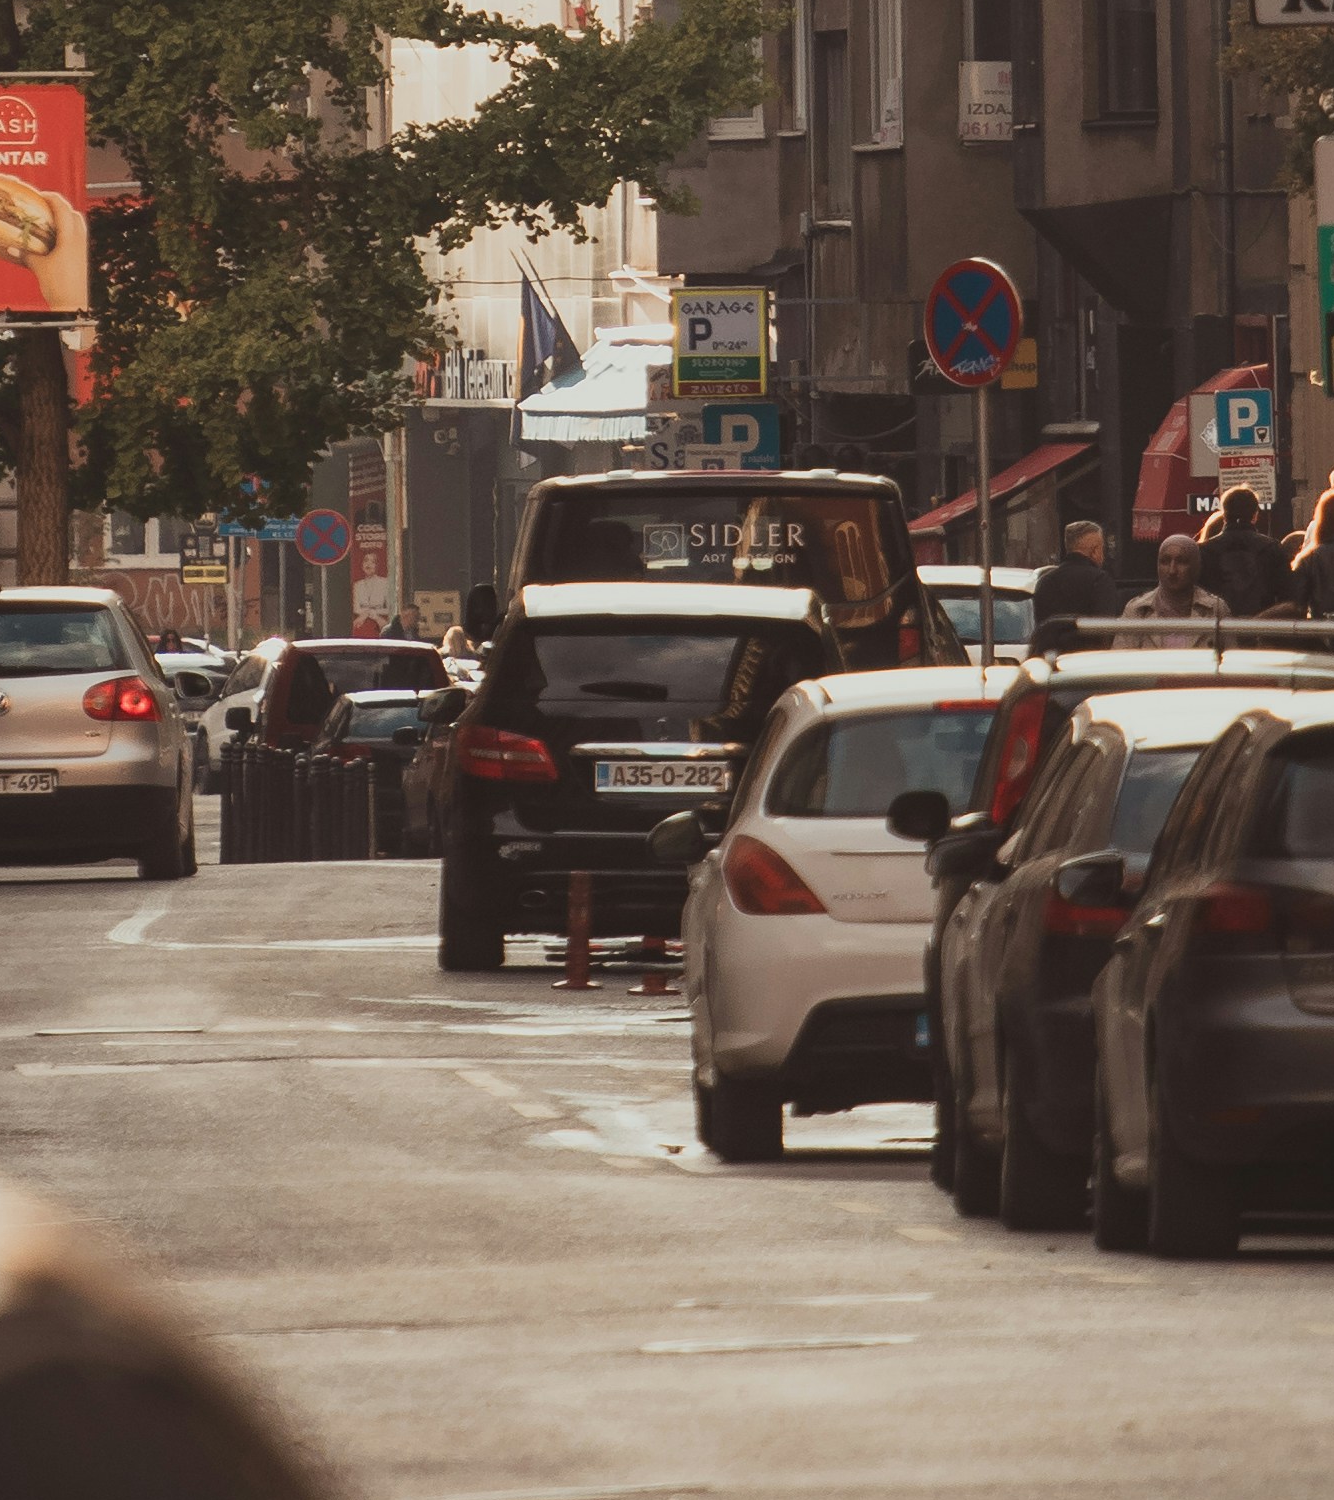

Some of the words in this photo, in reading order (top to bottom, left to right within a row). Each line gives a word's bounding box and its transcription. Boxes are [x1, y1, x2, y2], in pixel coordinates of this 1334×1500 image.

[681, 302, 755, 315] GARAGE
[688, 317, 713, 350] P
[1229, 398, 1259, 439] P
[690, 523, 805, 547] SIDLER
[701, 553, 726, 564] ART
